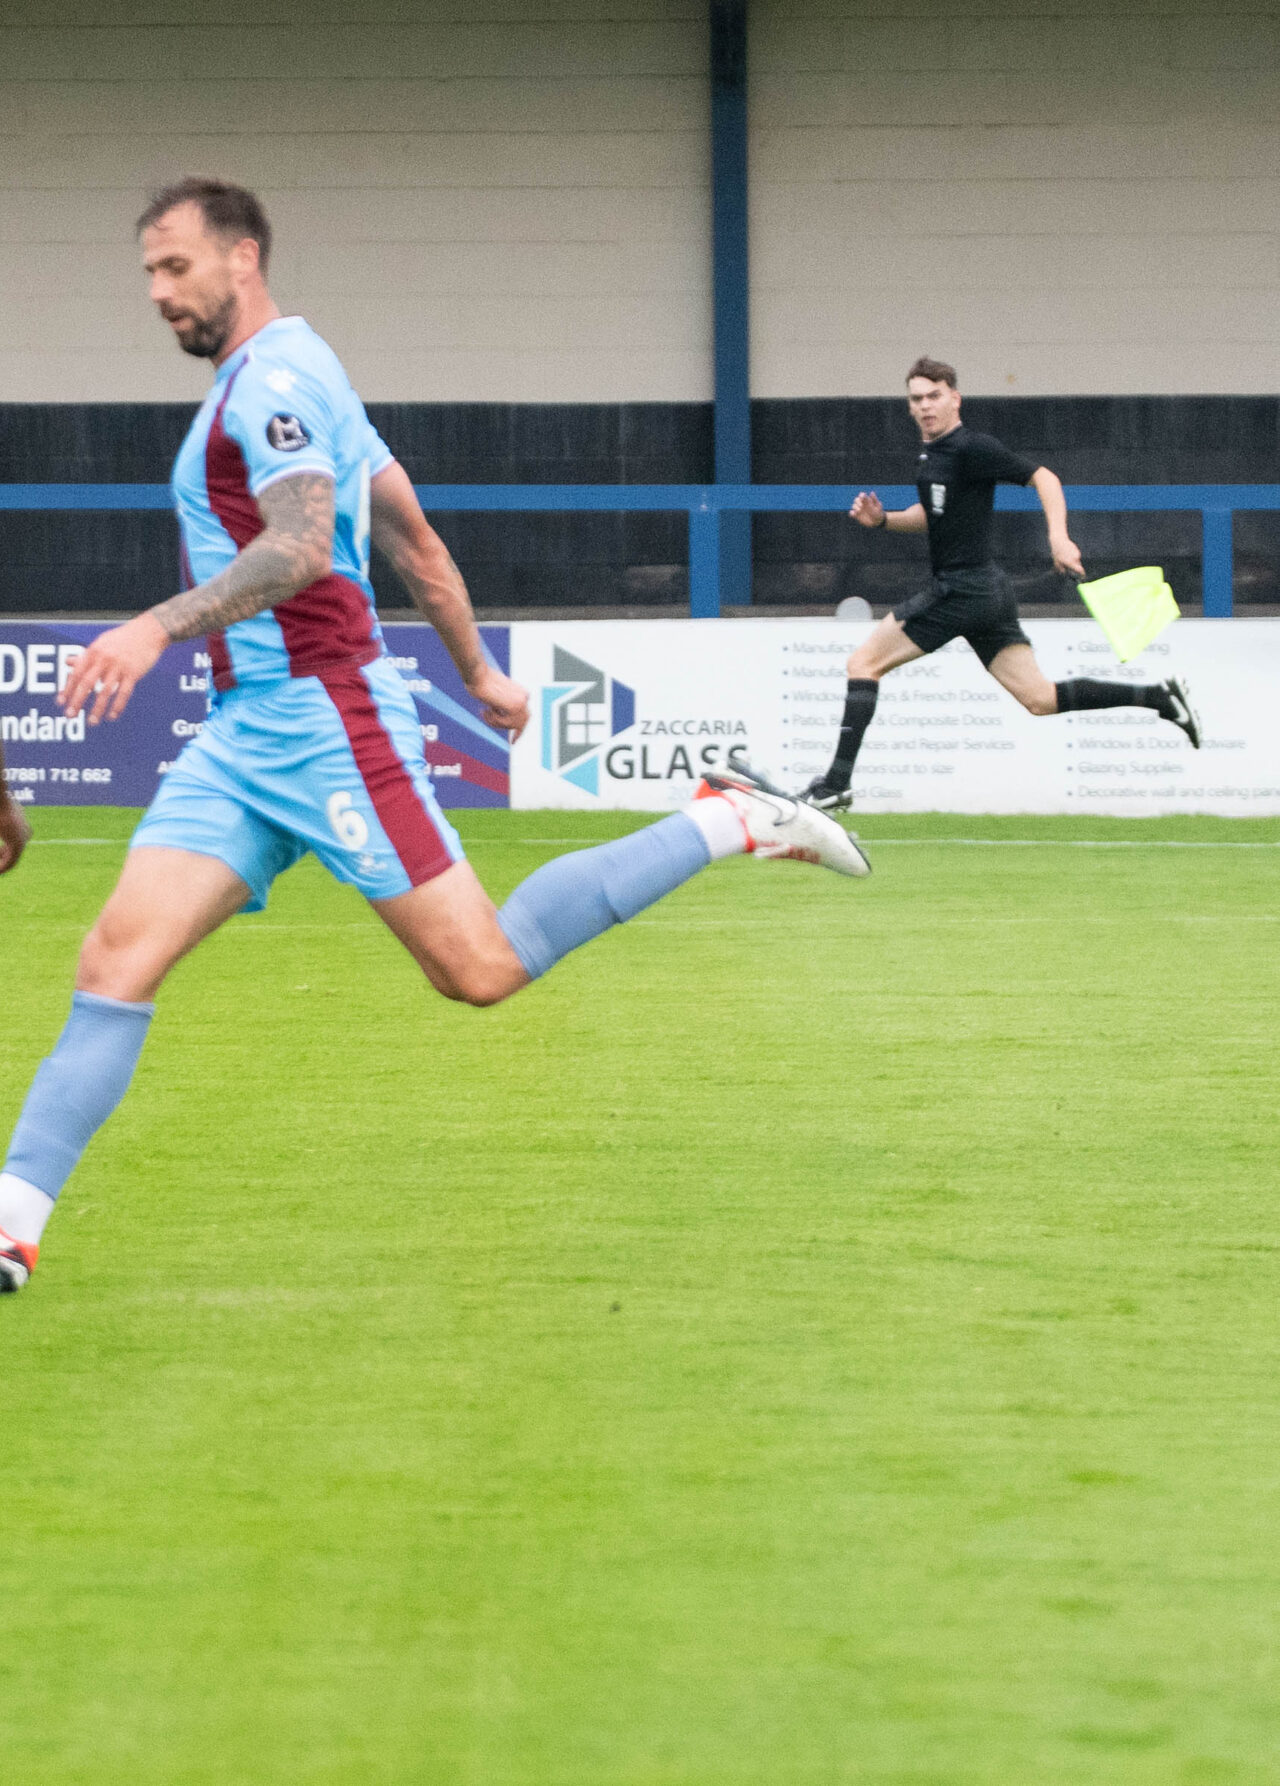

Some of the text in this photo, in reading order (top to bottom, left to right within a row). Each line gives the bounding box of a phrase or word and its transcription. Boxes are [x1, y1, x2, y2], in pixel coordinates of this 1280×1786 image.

[960, 690, 999, 702] Doors
[963, 714, 1002, 726] Doors
[640, 720, 747, 735] ZACCARIA
[963, 738, 1016, 750] Services
[49, 767, 79, 782] 712
[81, 767, 112, 782] 662
[327, 790, 368, 851] 6
